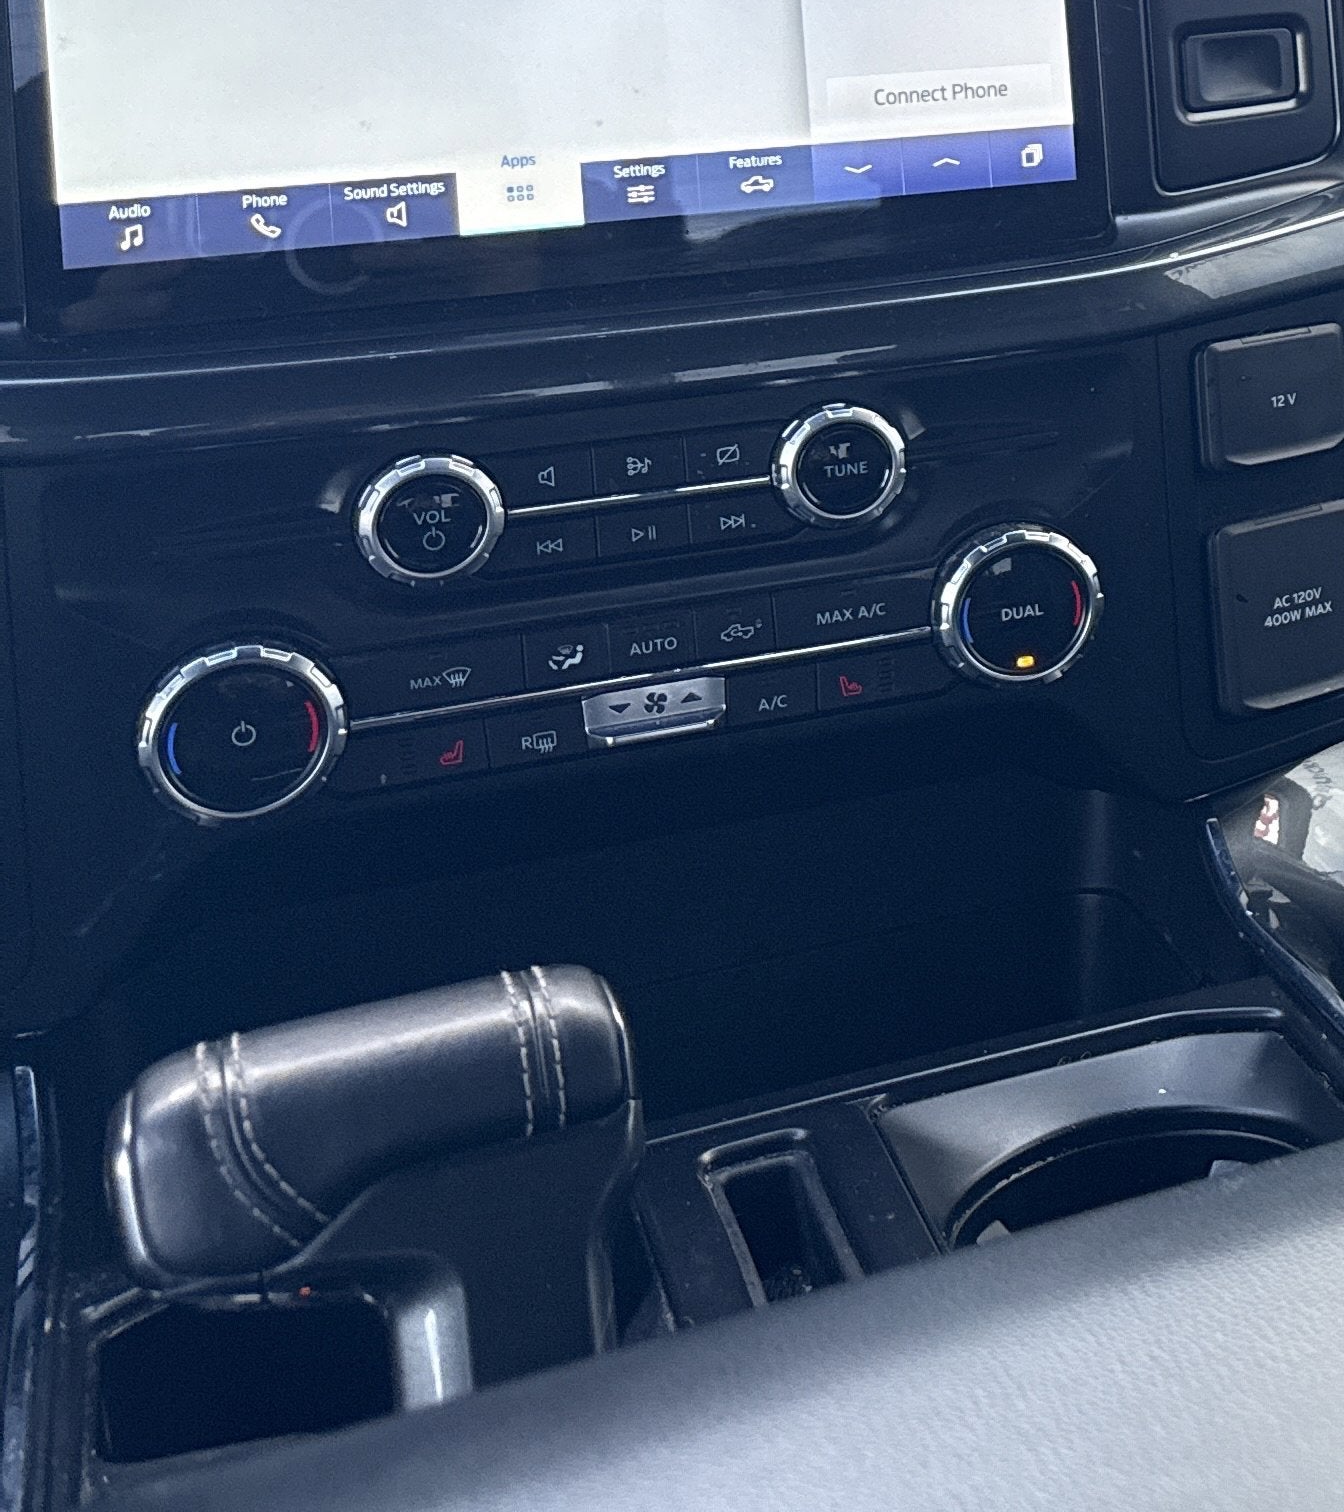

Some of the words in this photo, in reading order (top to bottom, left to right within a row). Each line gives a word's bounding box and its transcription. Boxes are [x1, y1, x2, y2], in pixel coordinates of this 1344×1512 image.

[873, 85, 948, 106] Connect
[952, 82, 1008, 100] Phone
[500, 155, 536, 170] Apps
[613, 163, 666, 179] Settings
[728, 155, 783, 170] Features
[343, 184, 388, 201] Sound
[389, 181, 446, 197] Settings
[242, 193, 288, 210] Phone
[108, 204, 151, 221] Audio
[1270, 394, 1286, 408] 12
[1286, 392, 1297, 405] V
[824, 461, 869, 478] TUNE
[413, 509, 451, 525] VOL
[1273, 594, 1291, 610] AC
[1292, 586, 1322, 605] 120V
[816, 608, 853, 626] MAX
[857, 602, 887, 619] A/C
[1001, 603, 1044, 621] DUAL
[1263, 608, 1302, 628] 400W
[1304, 600, 1333, 619] MAX
[629, 636, 678, 656] AUTO
[410, 674, 442, 690] MAX
[758, 694, 788, 712] A/C
[521, 736, 533, 751] R
